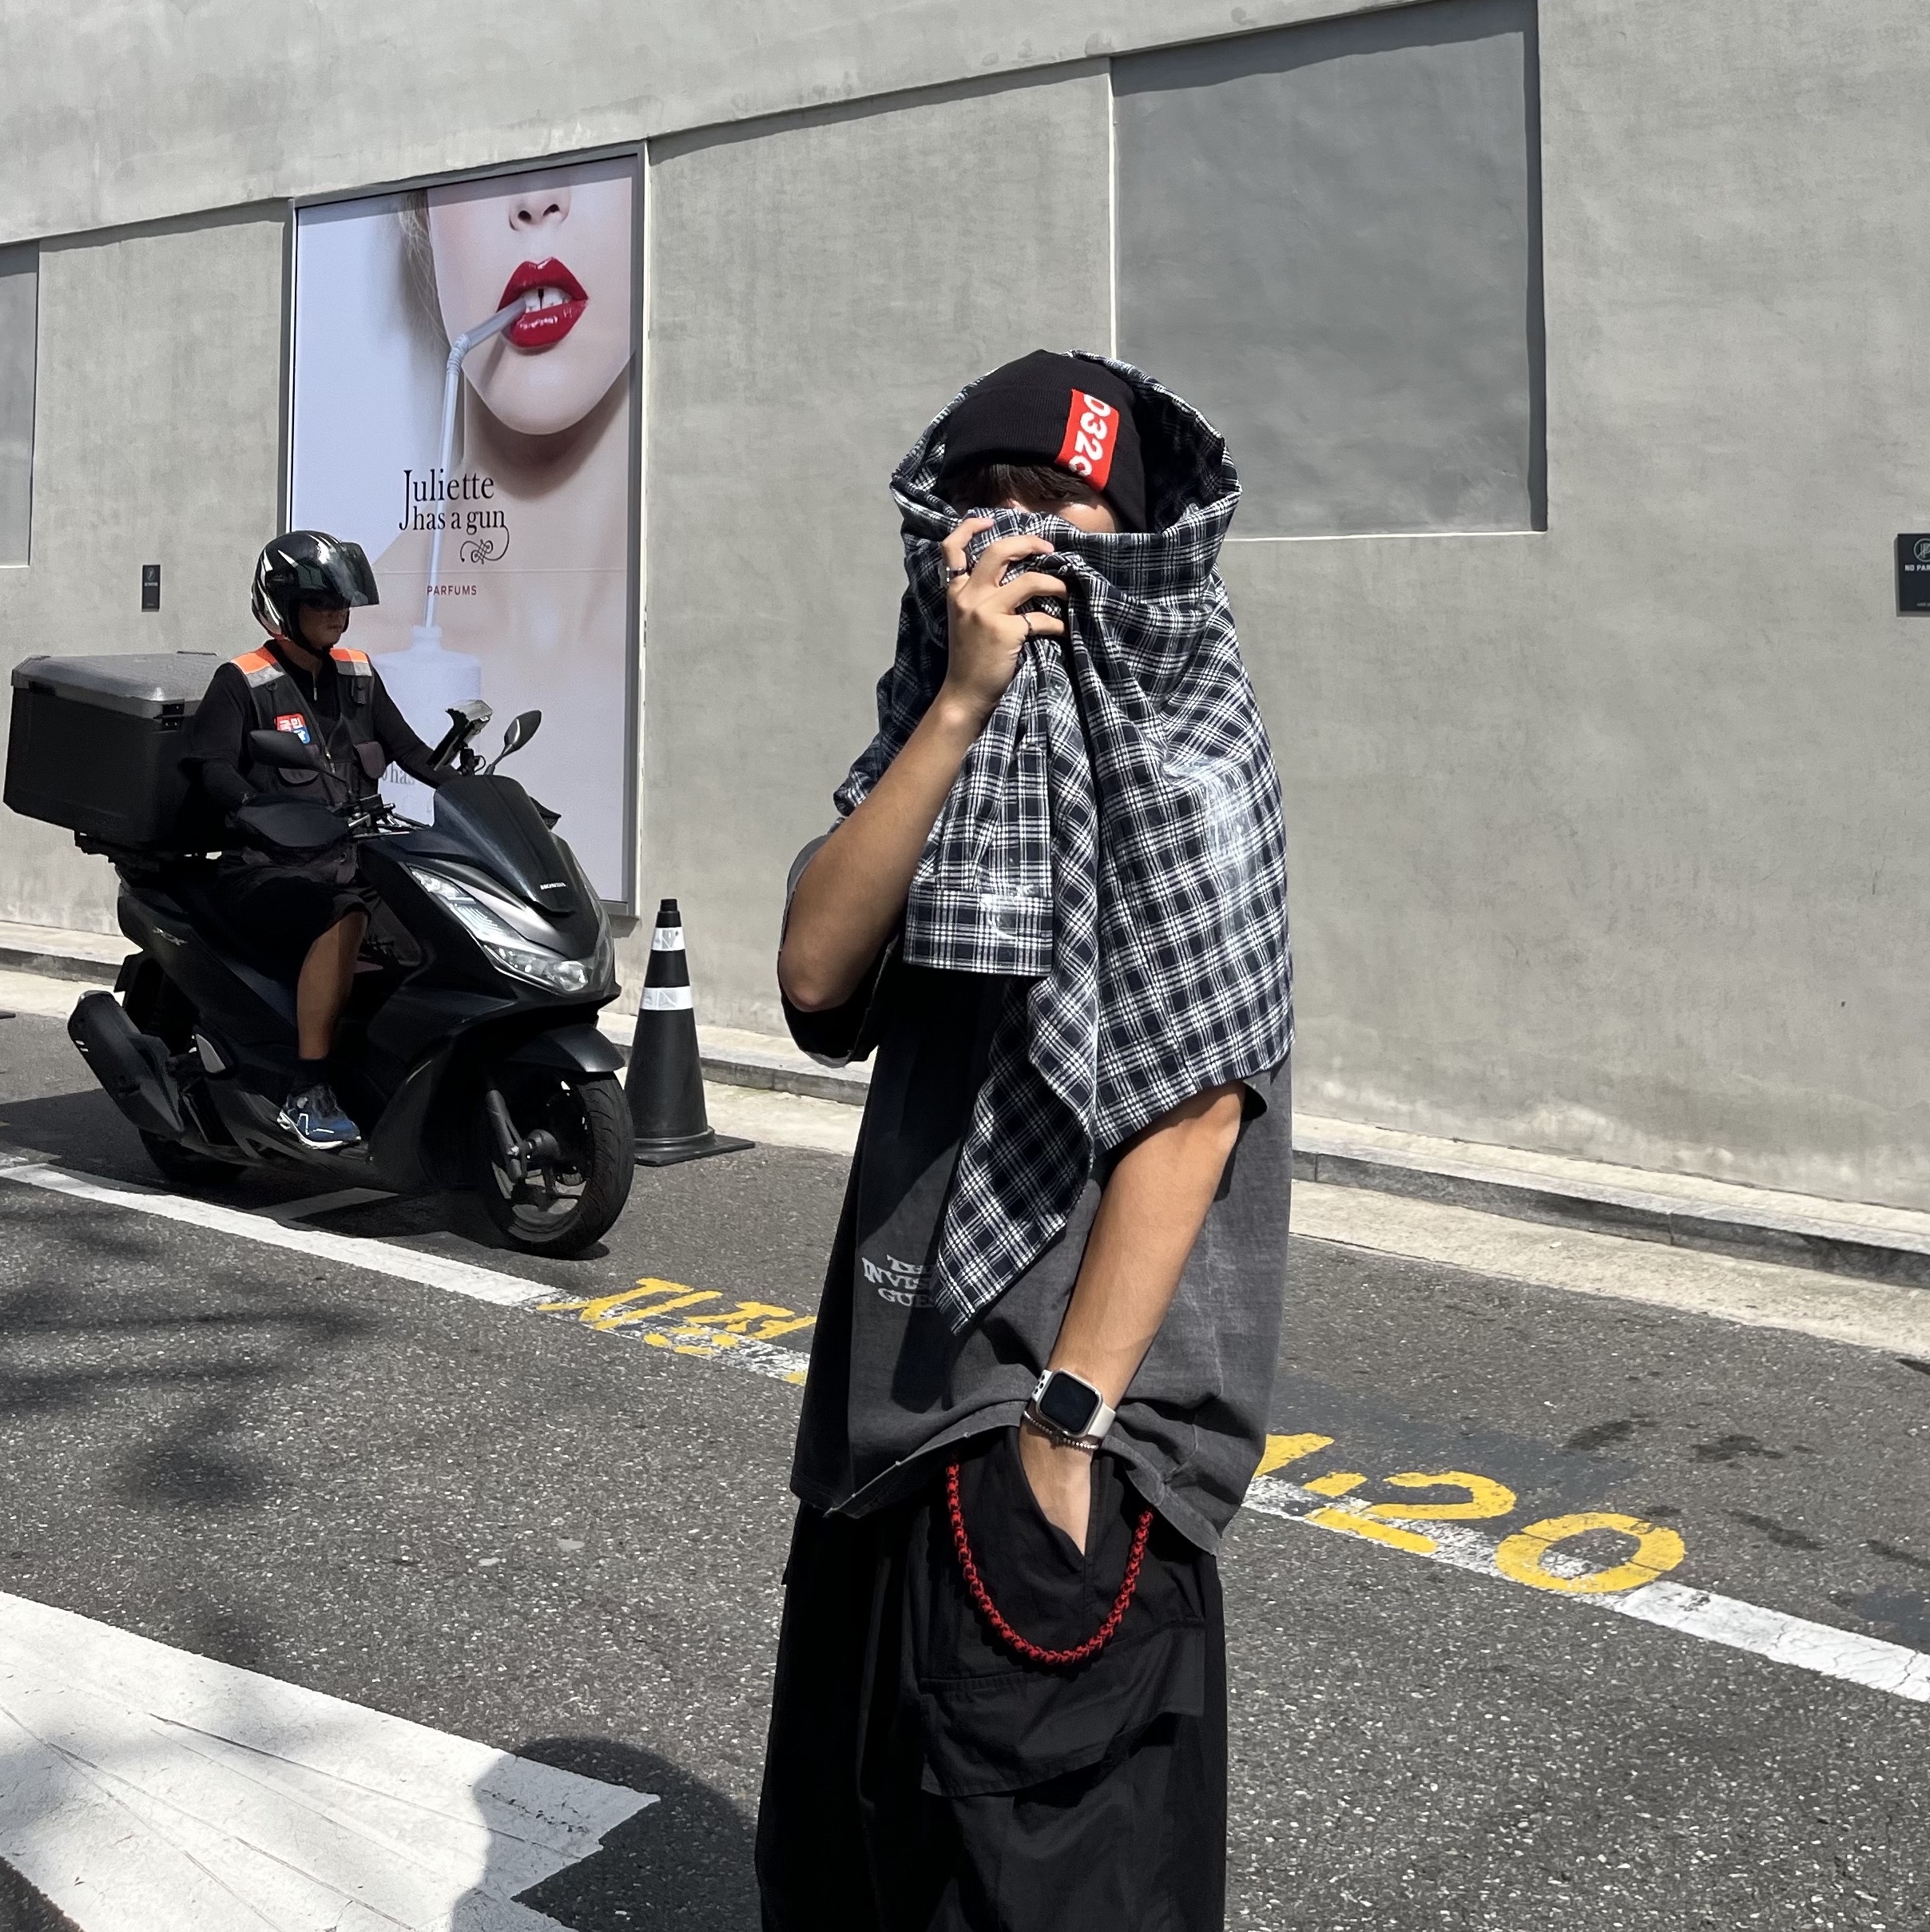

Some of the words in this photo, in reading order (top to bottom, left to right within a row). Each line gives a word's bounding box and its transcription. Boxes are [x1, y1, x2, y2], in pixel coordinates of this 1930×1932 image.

[399, 468, 494, 531] Juliette
[412, 506, 446, 531] has
[451, 511, 462, 530] a
[467, 510, 506, 535] gun
[427, 585, 477, 596] PARFUMS
